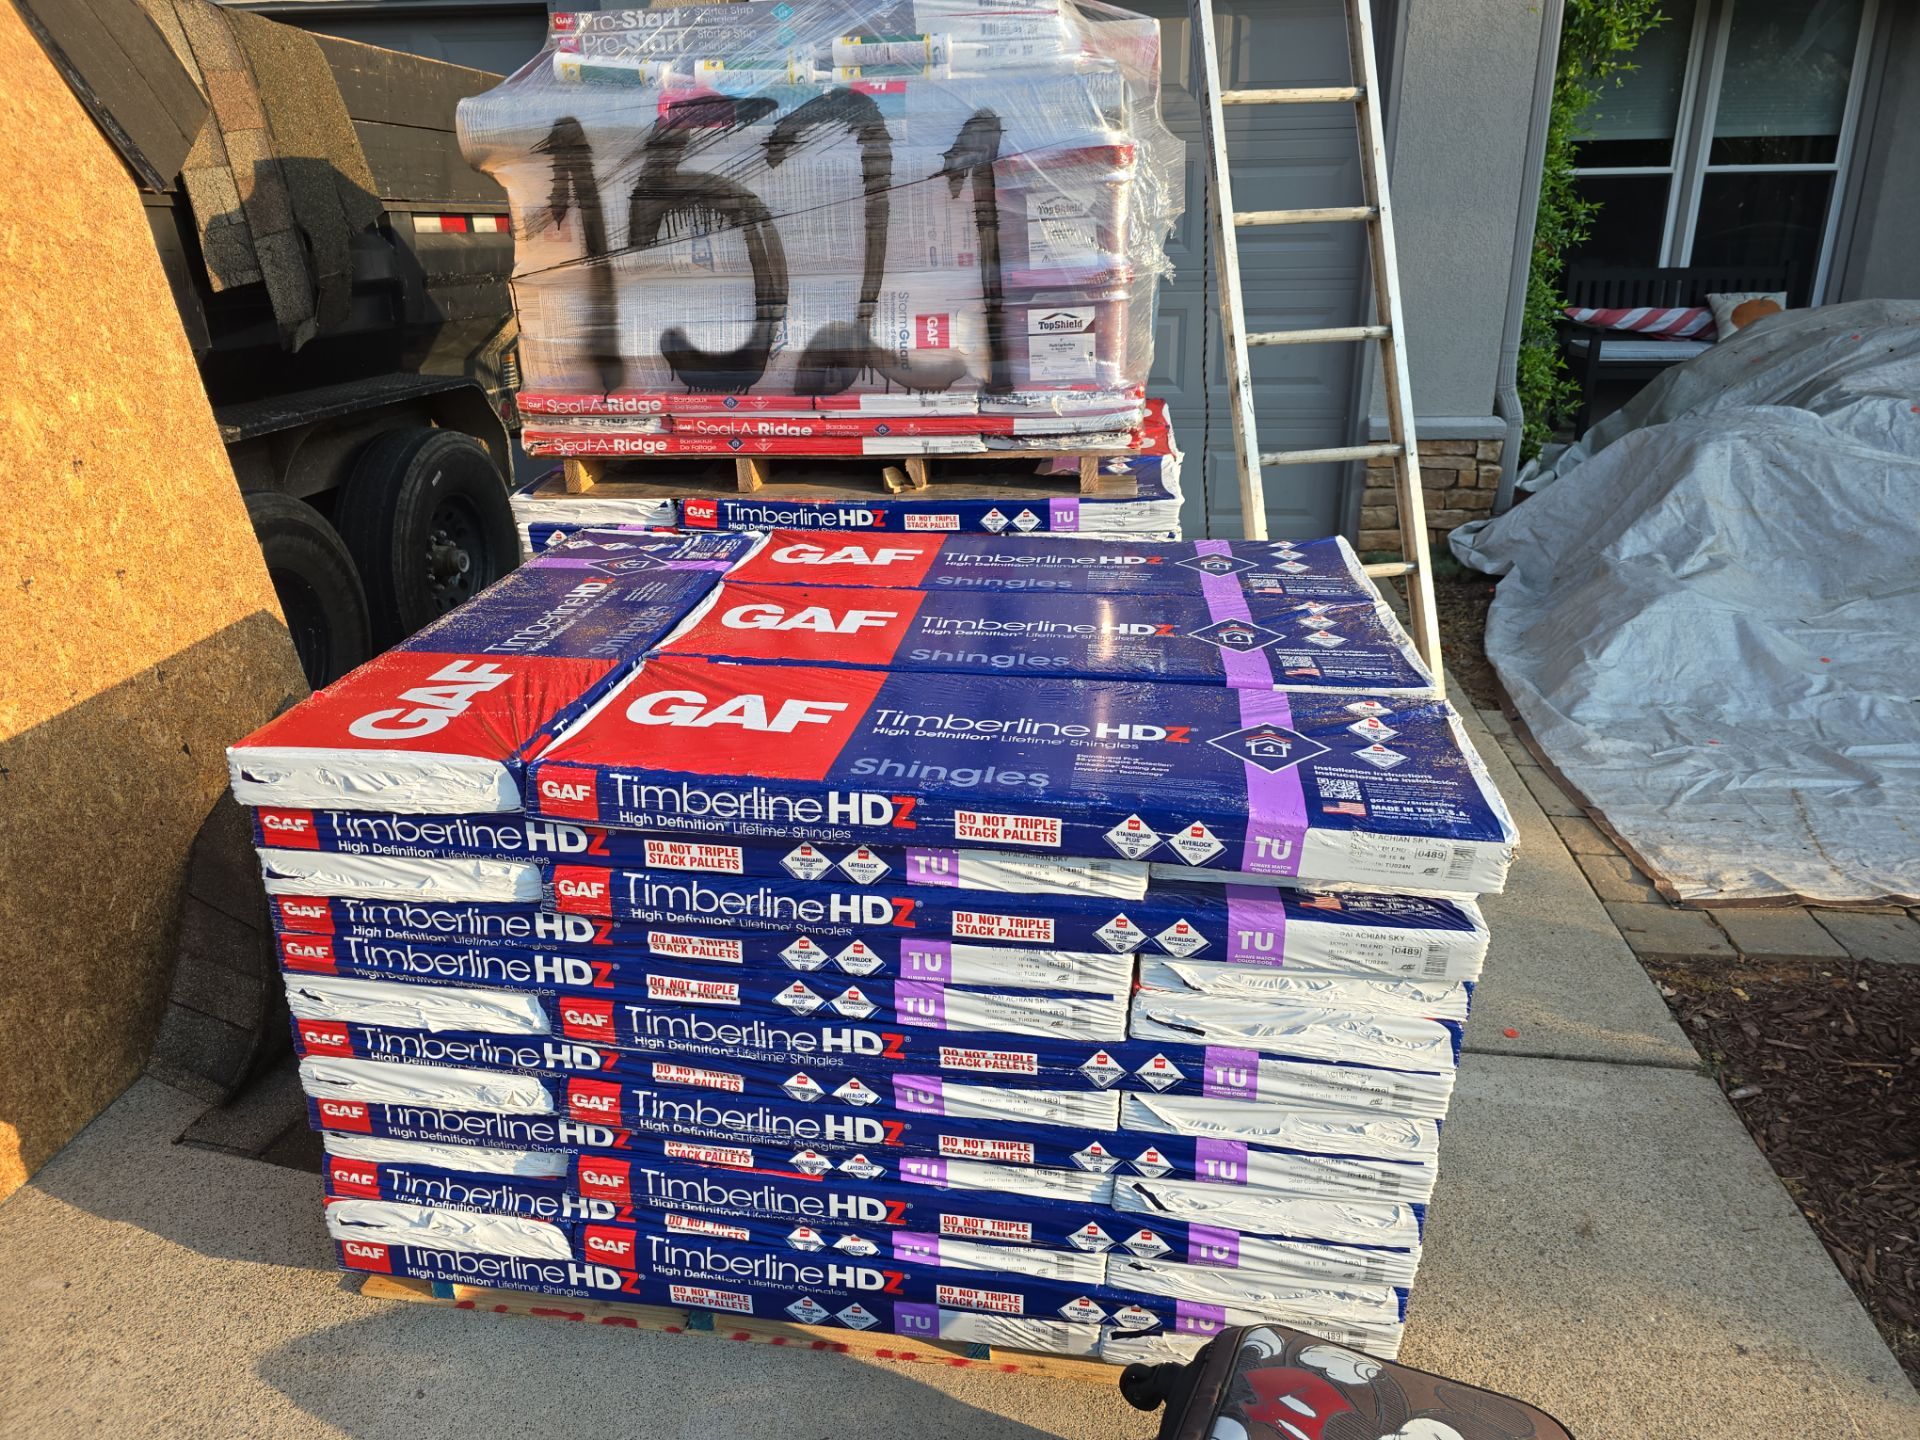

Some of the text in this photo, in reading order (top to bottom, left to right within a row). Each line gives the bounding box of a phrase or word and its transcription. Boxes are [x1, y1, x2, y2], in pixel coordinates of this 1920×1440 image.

[926, 316, 939, 346] GAF
[1038, 319, 1083, 331] TopShield
[696, 420, 813, 437] Seal-A-Ridge
[554, 438, 668, 454] Seal-A-Ridge
[686, 505, 716, 519] GAF
[1054, 511, 1075, 524] TU
[770, 543, 924, 566] GAF
[935, 576, 1073, 589] Shingles
[721, 603, 899, 634] GAF
[909, 648, 1071, 669] Shingles
[347, 659, 515, 740] GAF
[625, 690, 849, 734] GAF
[872, 726, 1139, 751] High Shingles
[849, 757, 1050, 788] Shingles
[540, 780, 591, 801] GAF
[1370, 804, 1401, 813] MADE
[263, 814, 310, 833] GAF
[619, 810, 852, 841] High Shingles
[958, 812, 1059, 832] DO NOT TRIPLE
[959, 823, 1059, 844] STACK PALLETS
[337, 839, 371, 855] High
[647, 841, 740, 860] DO NOT TRIPLE
[1254, 836, 1294, 861] TU
[648, 852, 741, 871] STACK PALLETS
[914, 856, 950, 876] TU
[558, 879, 606, 900] GAF
[282, 901, 328, 918] GAF
[631, 907, 665, 923] High
[955, 912, 1052, 930] DO NOT TRIPLE
[956, 922, 1052, 941] STACK PALLETS
[1237, 930, 1275, 952] TU
[285, 943, 330, 959] GAF
[690, 945, 740, 960] PALLETS
[908, 951, 943, 972] TU
[649, 976, 737, 996] DO NOT TRIPLE
[903, 996, 937, 1017] TU
[564, 1008, 610, 1028] GAF
[304, 1031, 346, 1046] GAF
[983, 1058, 1035, 1073] PALLETS
[1211, 1066, 1248, 1087] TU
[321, 1102, 365, 1119] GAF
[570, 1092, 617, 1112] GAF
[941, 1135, 1032, 1152] DO NOT TRIPLE
[667, 1148, 751, 1165] STACK PALLETS
[332, 1169, 375, 1186] GAF
[582, 1170, 625, 1188] GAF
[1203, 1160, 1239, 1180] TU
[943, 1214, 1030, 1233] DO NOT TRIPLE
[345, 1243, 386, 1260] GAF
[588, 1235, 632, 1255] GAF
[652, 1262, 682, 1278] High
[407, 1266, 590, 1298] High Shingles
[672, 1285, 750, 1304] DO NOT TRIPLE
[673, 1293, 752, 1312] STACK PALLETS
[938, 1294, 1021, 1314] STACK PALLETS
[939, 1286, 1021, 1304] DO NOT TRIPLE
[901, 1313, 932, 1330] TU
